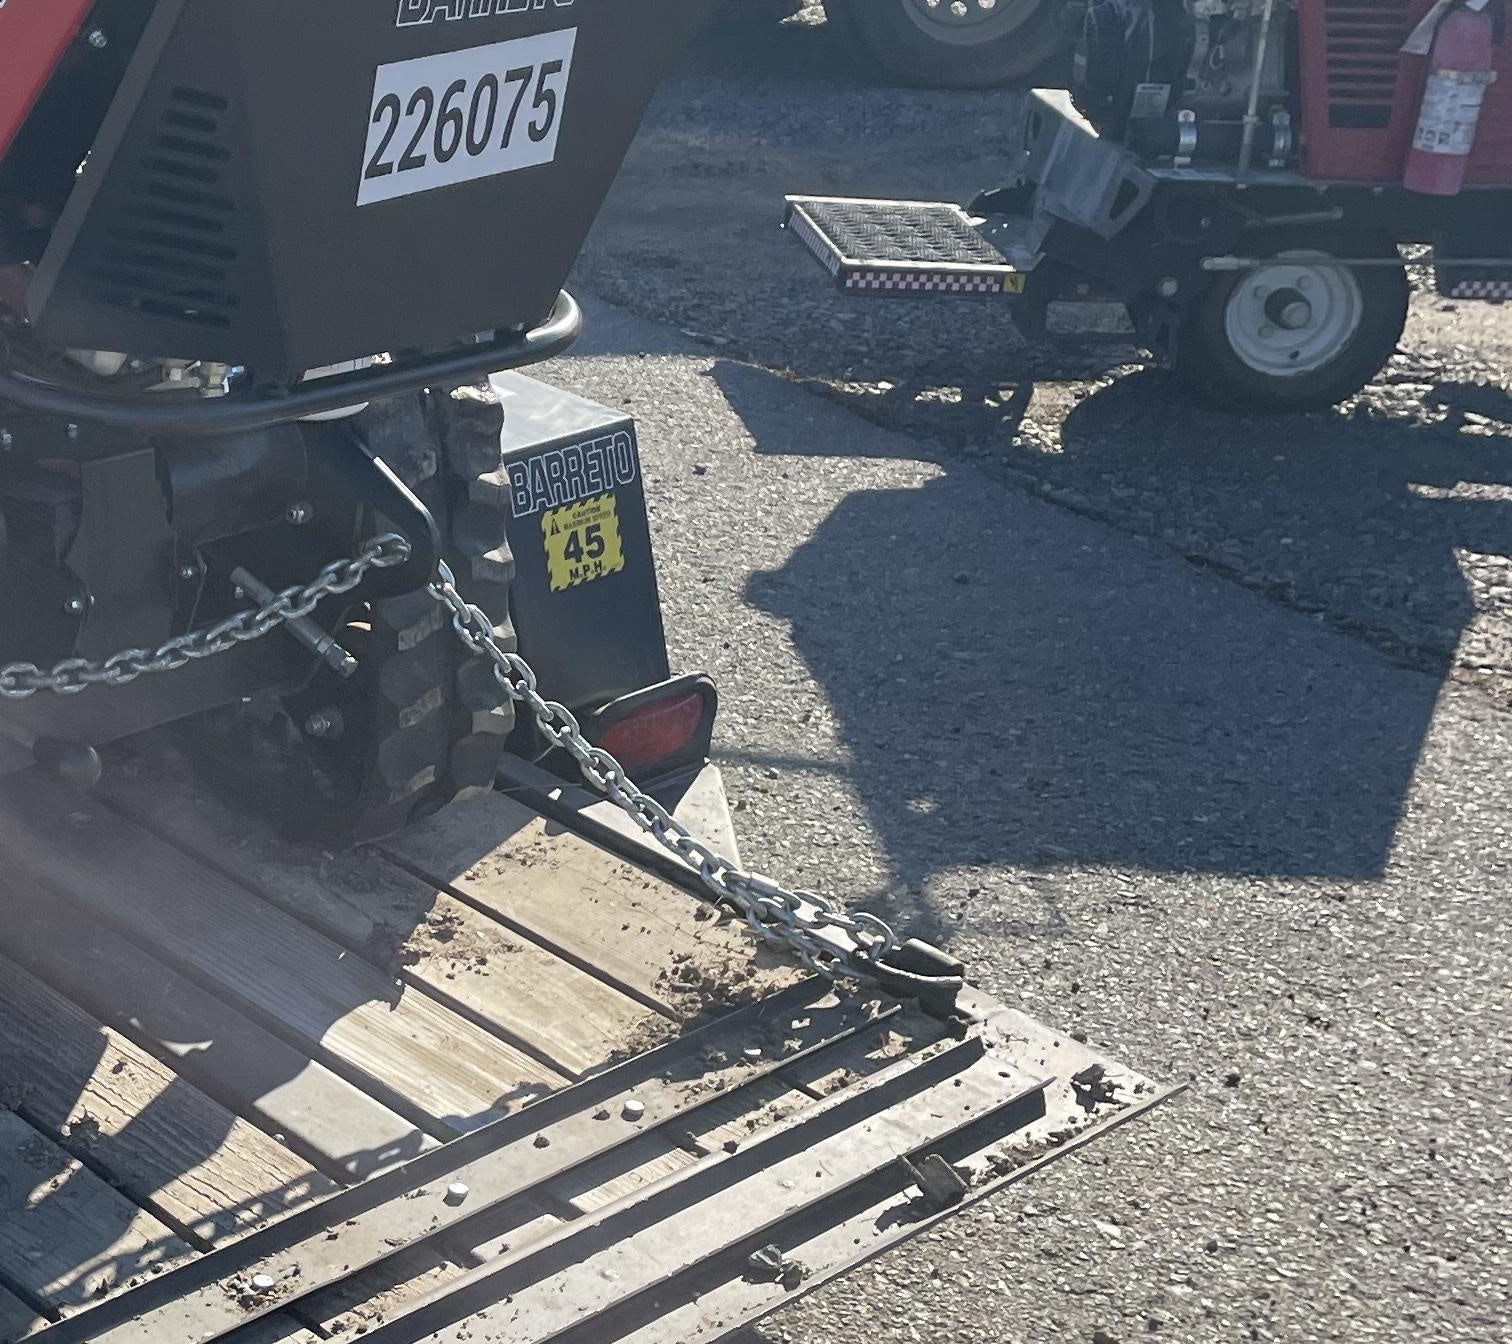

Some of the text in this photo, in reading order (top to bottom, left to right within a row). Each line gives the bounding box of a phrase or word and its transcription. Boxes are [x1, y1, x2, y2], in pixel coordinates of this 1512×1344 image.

[364, 59, 563, 180] 226075
[506, 430, 636, 518] BARRETO
[564, 522, 605, 563] 45
